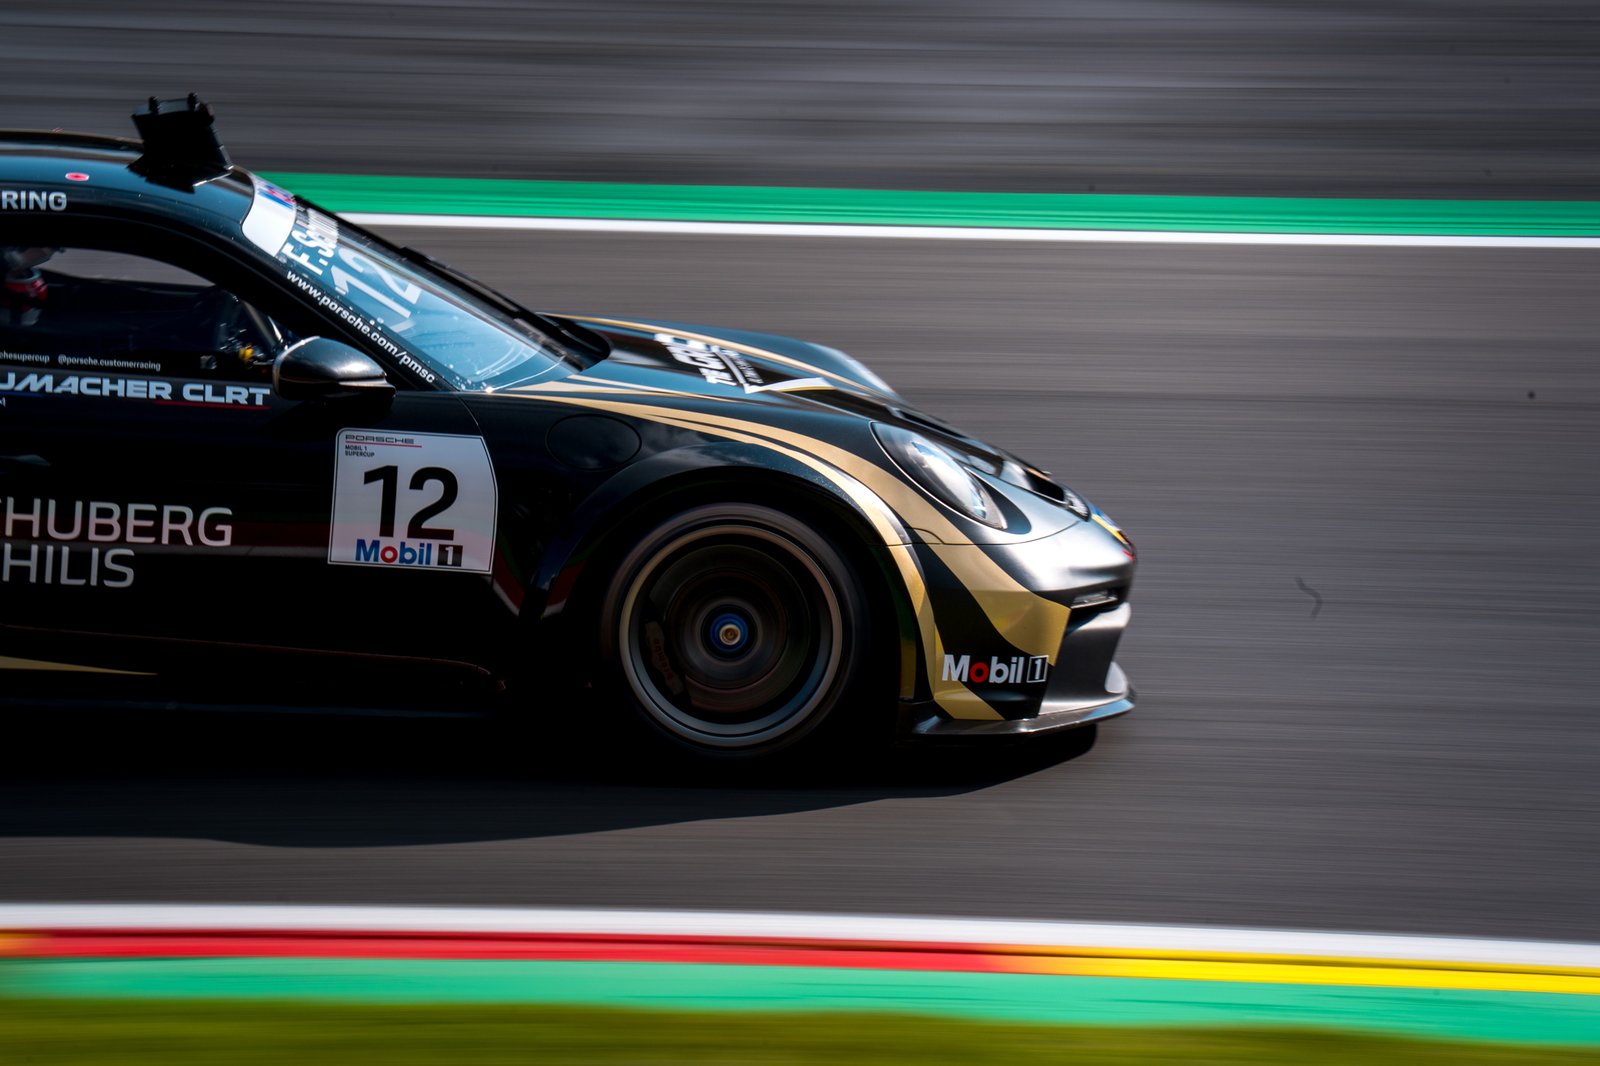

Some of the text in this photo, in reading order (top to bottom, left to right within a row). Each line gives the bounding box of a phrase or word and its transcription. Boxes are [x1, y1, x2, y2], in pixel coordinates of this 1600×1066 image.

[2, 190, 67, 211] RING
[286, 270, 436, 384] www.porsche.com/pmsc
[58, 354, 161, 372] @porsche.customerracing
[182, 383, 270, 406] CLRT
[345, 434, 415, 445] PORSCHE
[364, 465, 458, 540] 12
[0, 496, 232, 547] HUBERG
[2, 543, 135, 588] HILIS
[356, 539, 432, 565] Mobil
[942, 654, 1025, 684] Mobil
